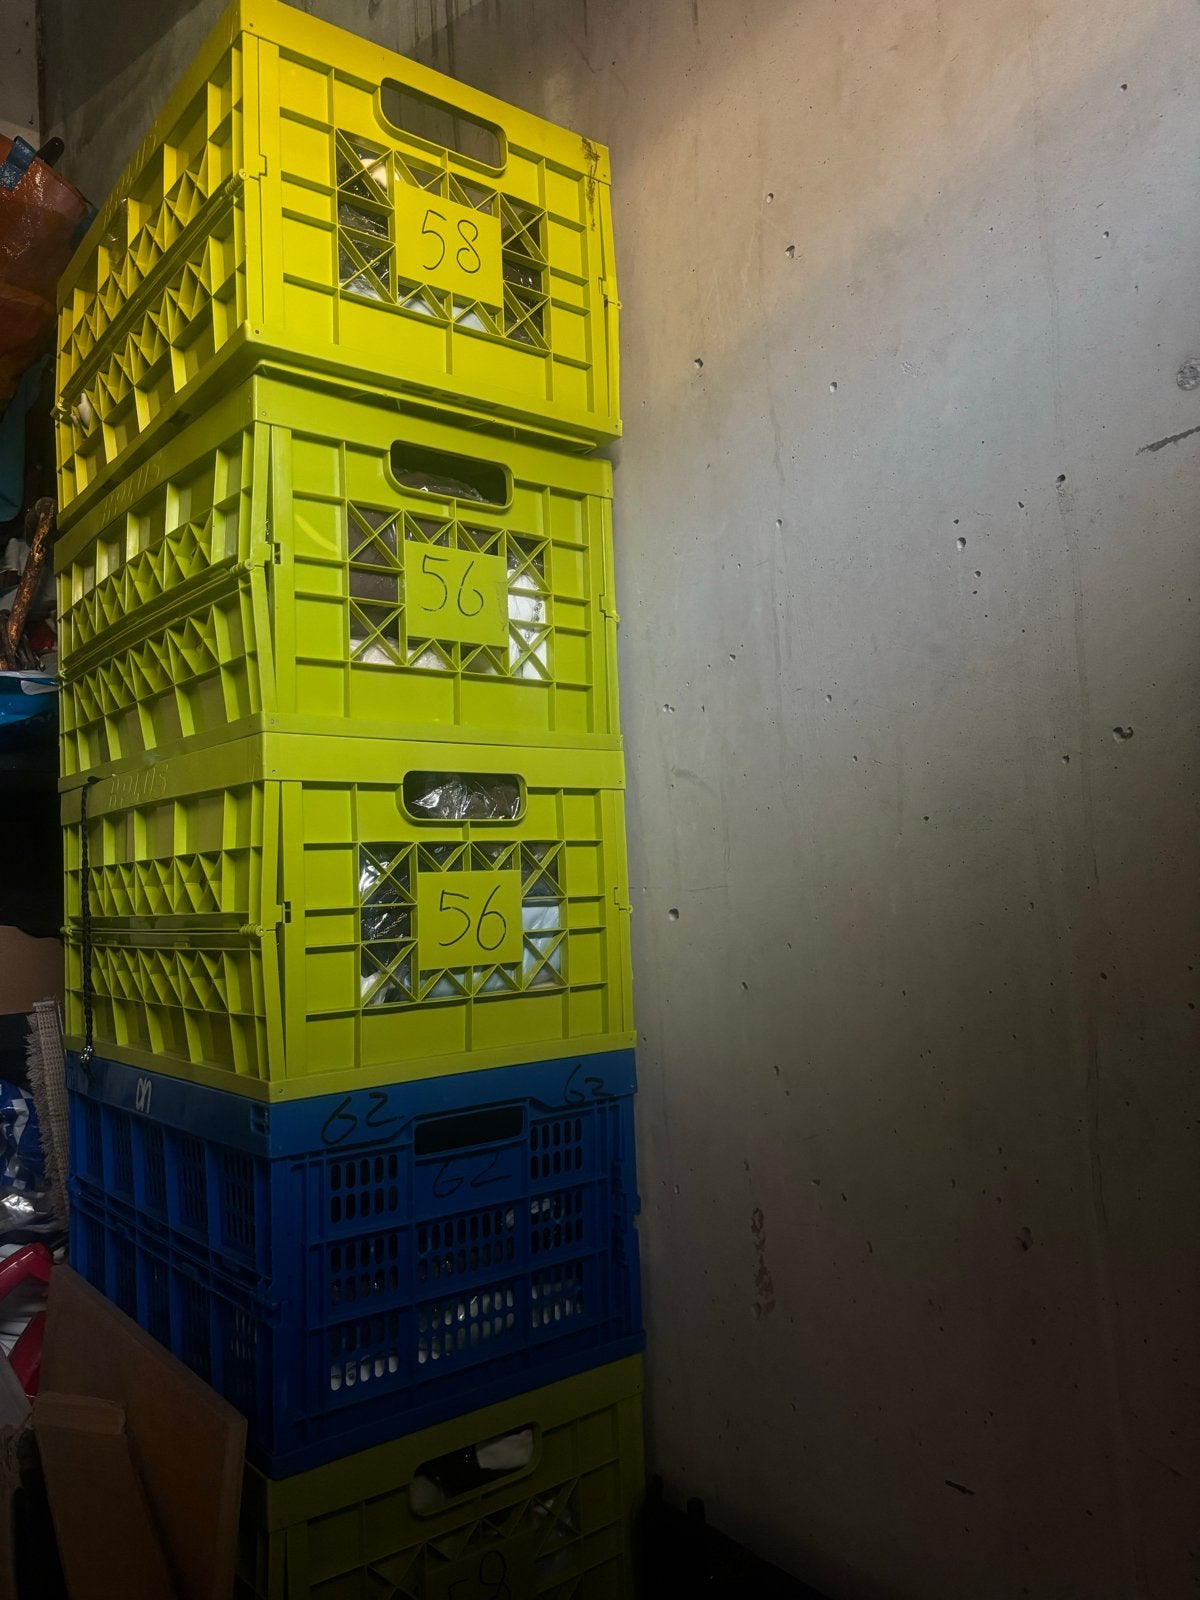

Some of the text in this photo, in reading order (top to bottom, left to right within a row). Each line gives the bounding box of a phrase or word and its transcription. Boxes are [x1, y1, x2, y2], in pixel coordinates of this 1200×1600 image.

[421, 208, 482, 274] 58
[419, 554, 484, 617] 56
[438, 884, 507, 951] 56
[564, 1063, 616, 1106] 62
[321, 1091, 405, 1146] 62
[431, 1152, 512, 1199] 62
